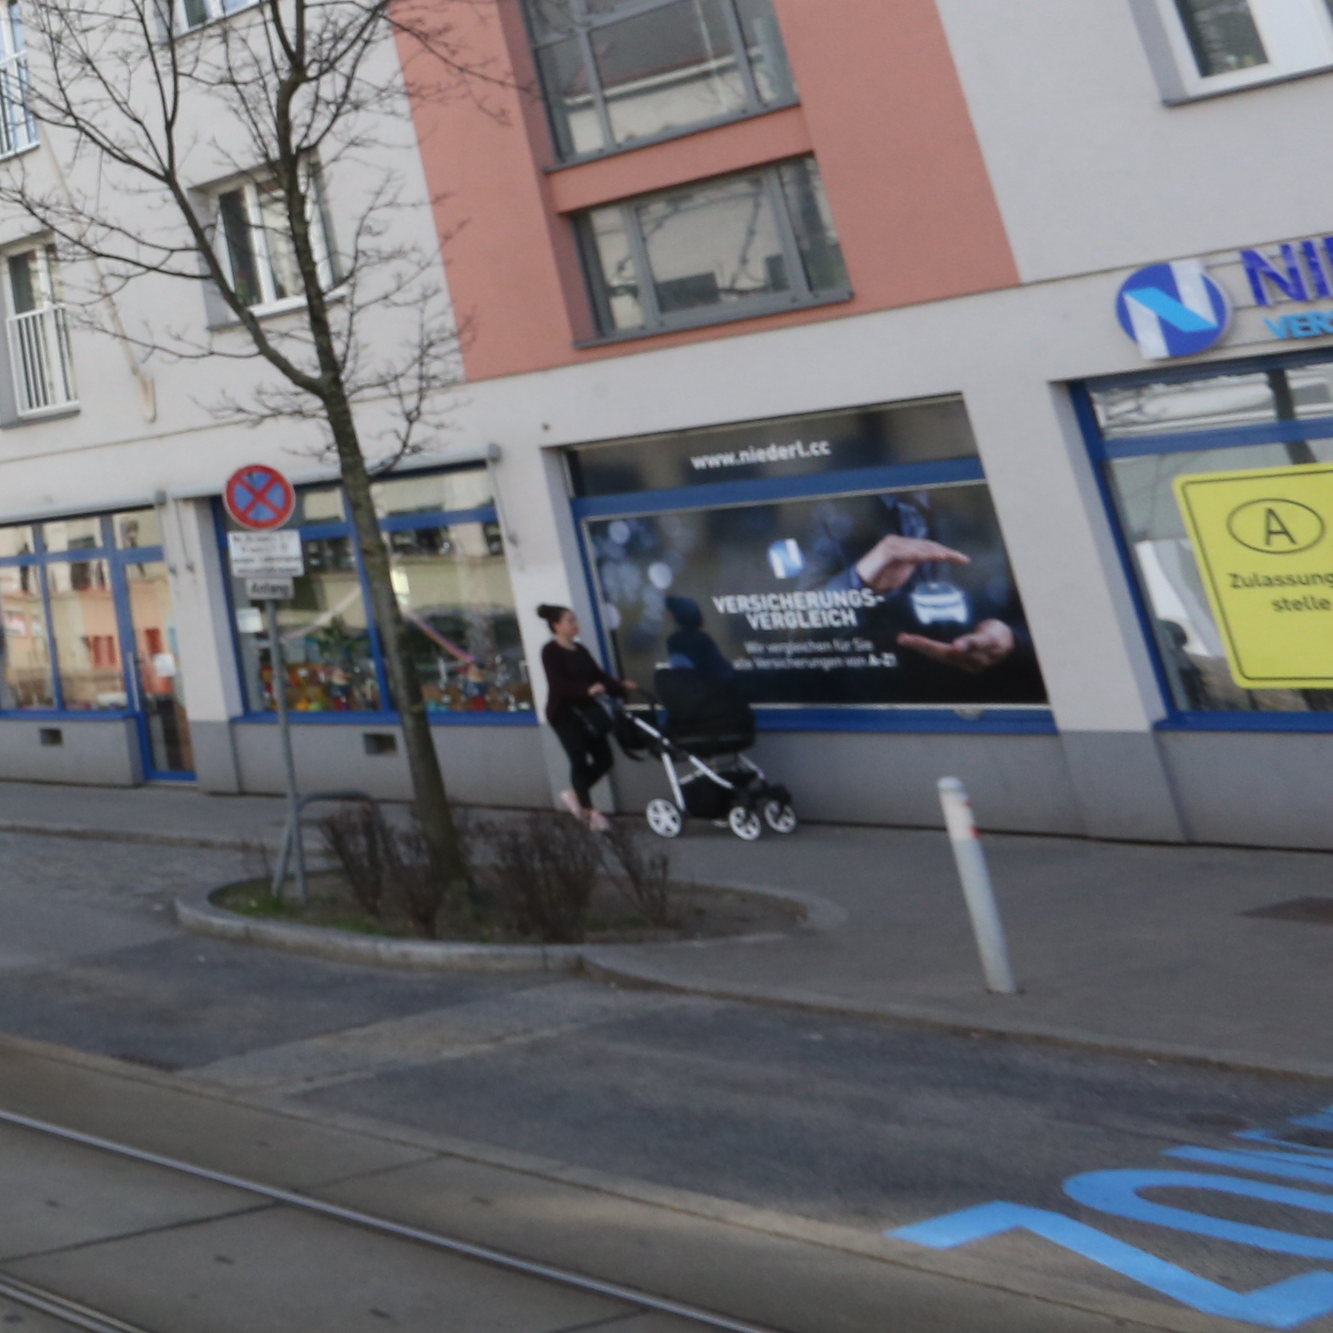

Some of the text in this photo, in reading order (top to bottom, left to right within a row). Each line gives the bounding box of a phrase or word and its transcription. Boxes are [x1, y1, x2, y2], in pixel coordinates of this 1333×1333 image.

[1261, 308, 1333, 341] VER
[690, 439, 832, 470] www.niederl.cc
[1264, 507, 1297, 546] A
[711, 587, 886, 614] VERSICHERUNGS-
[1272, 593, 1332, 612] stelle
[744, 608, 859, 631] VERGLEICH
